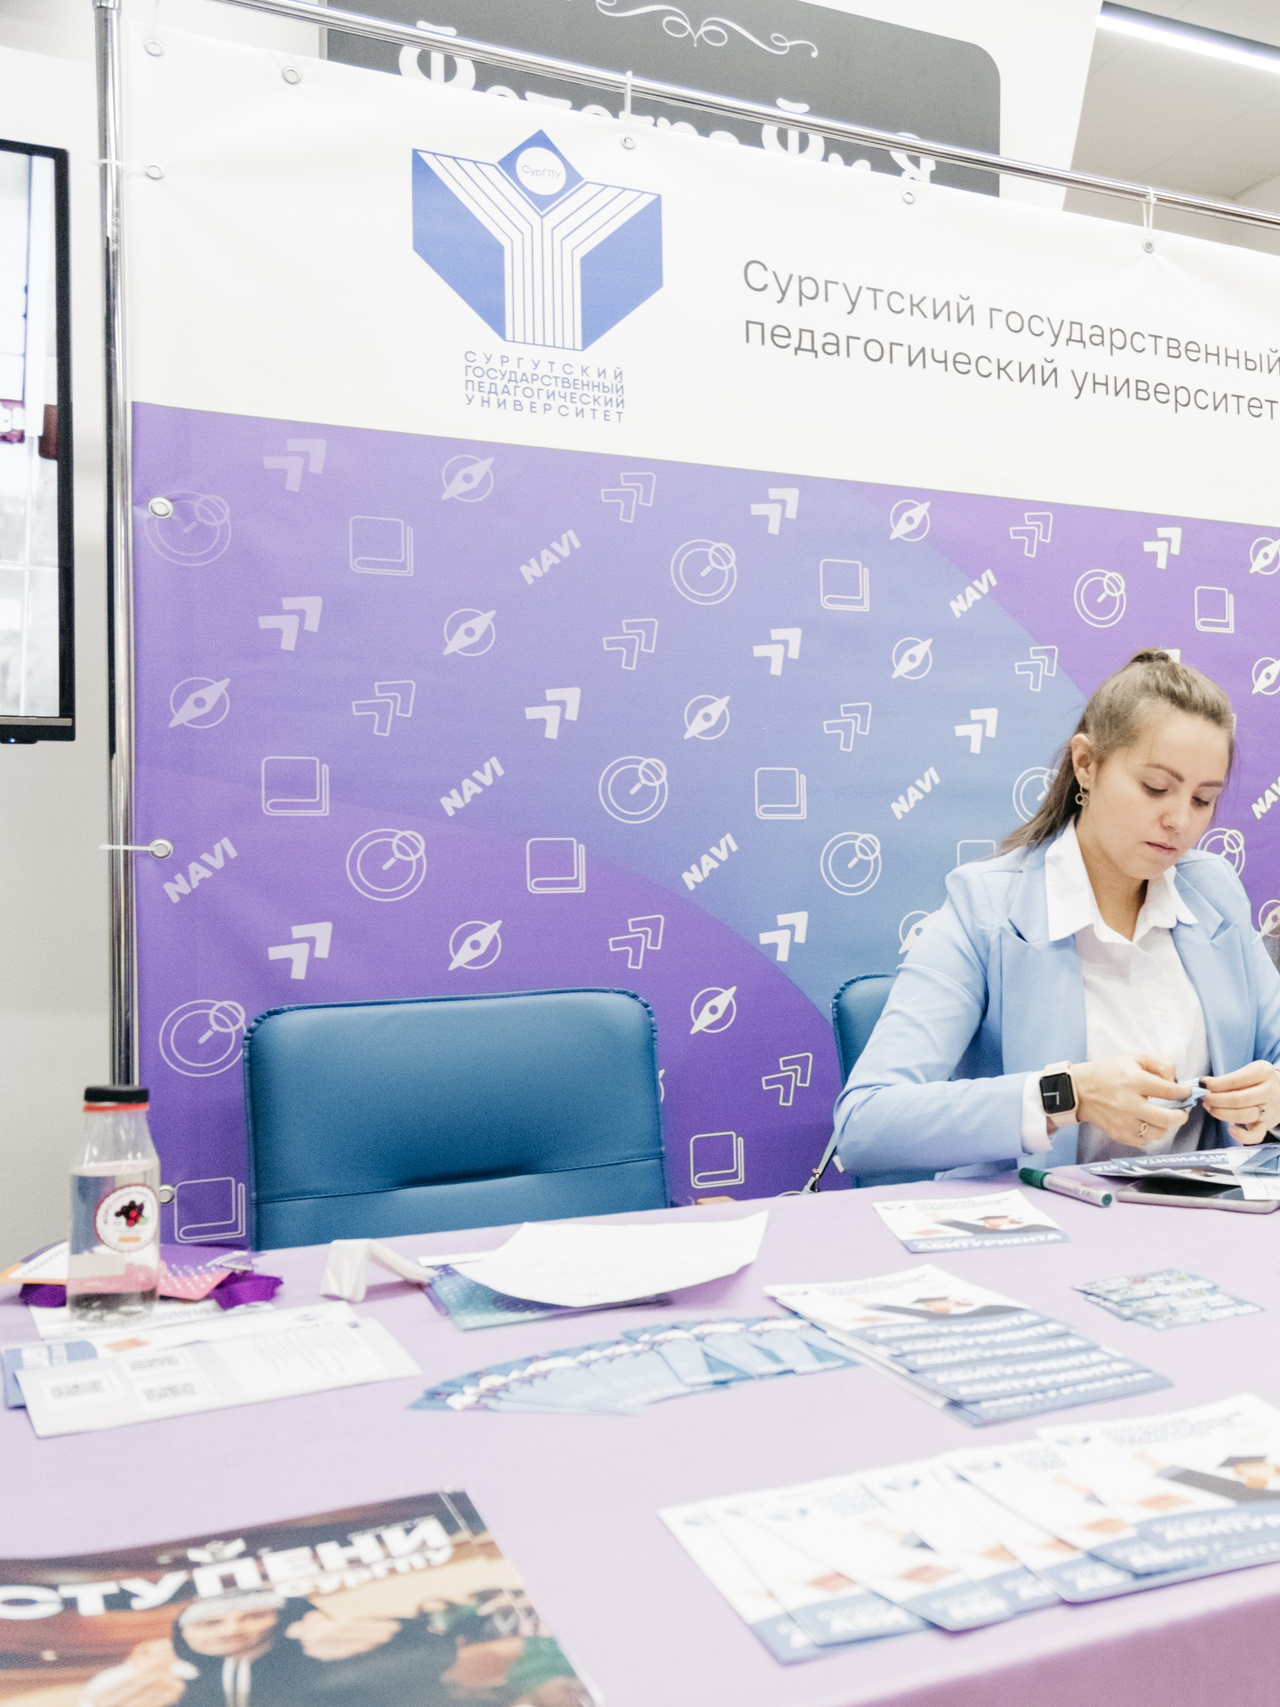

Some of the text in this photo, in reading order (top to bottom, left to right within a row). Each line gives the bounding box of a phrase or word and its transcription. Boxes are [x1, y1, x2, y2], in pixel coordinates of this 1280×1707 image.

[521, 164, 562, 179] СурГПУ
[743, 259, 976, 326] Сургутский
[464, 350, 624, 382] СУРГУТСКИЙ
[464, 365, 625, 396] ГОСУДАРСТВЕННЫЙ
[744, 315, 1279, 421] педагогический университет
[464, 379, 625, 409] ПЕДАГОГИЧЕСКИЙ
[465, 393, 624, 423] УНИВЕРСИТЕТ
[519, 529, 581, 585] NAVI
[949, 568, 998, 618] NAVI
[439, 755, 505, 817] NAVI
[890, 767, 941, 820] NAVI
[162, 836, 239, 904] NAVI
[681, 832, 740, 891] NAVI
[0, 1515, 453, 1621] СТУПЕНИ
